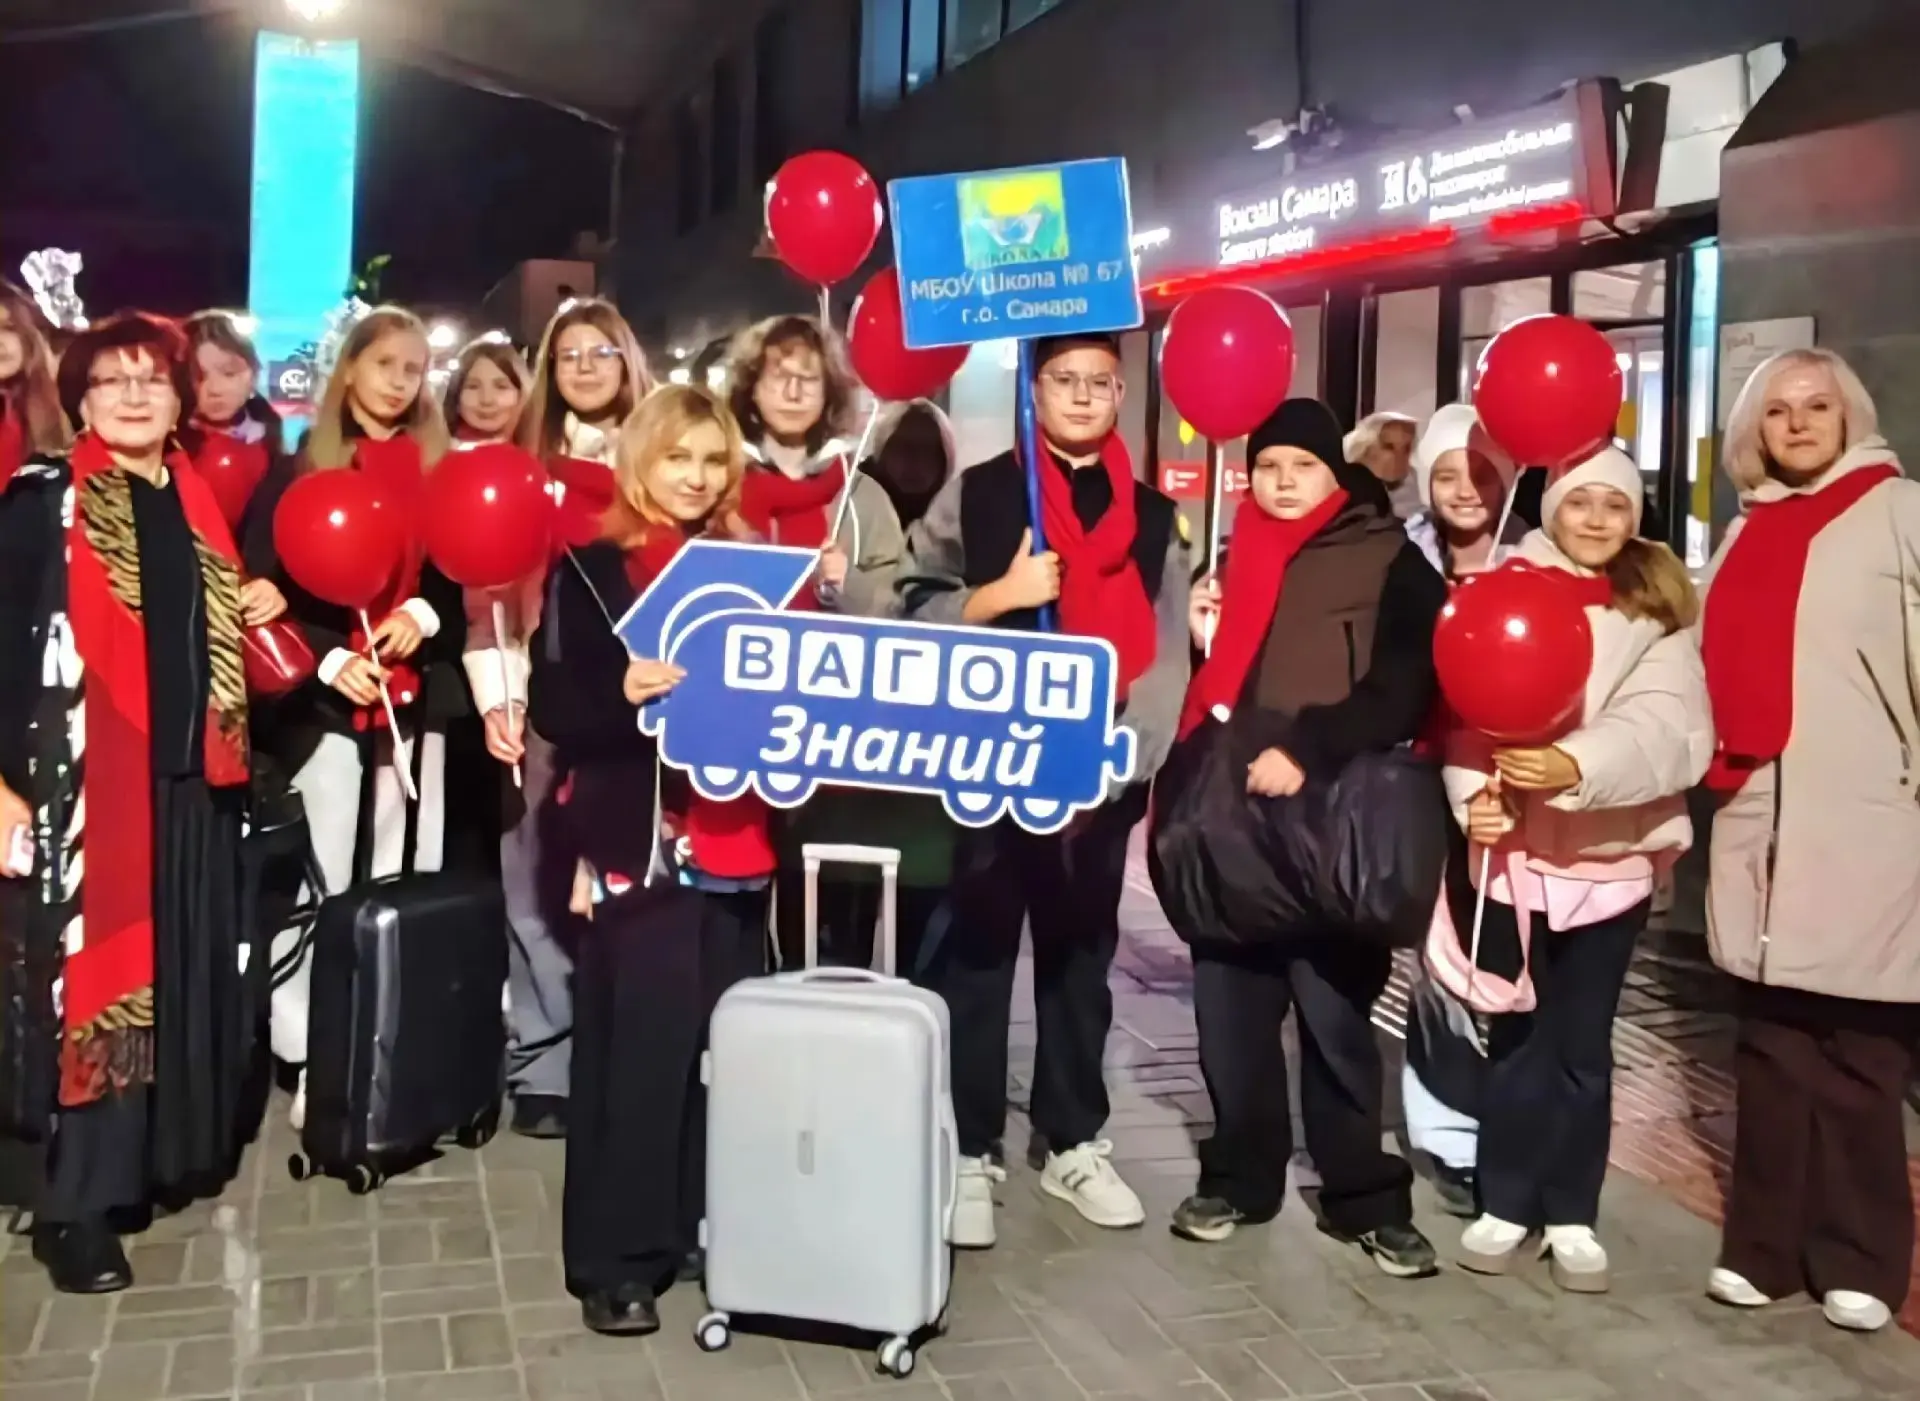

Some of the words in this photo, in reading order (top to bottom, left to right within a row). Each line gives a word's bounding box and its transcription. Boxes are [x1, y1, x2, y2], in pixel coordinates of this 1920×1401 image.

[1281, 178, 1356, 222] Самара
[910, 271, 975, 301] МБОУ
[981, 267, 1056, 296] Школа
[1097, 260, 1124, 282] 67
[961, 306, 999, 325] г.о.
[1006, 297, 1089, 321] Самара
[736, 633, 1079, 711] ВАГОН
[759, 704, 1045, 788] Знаний
